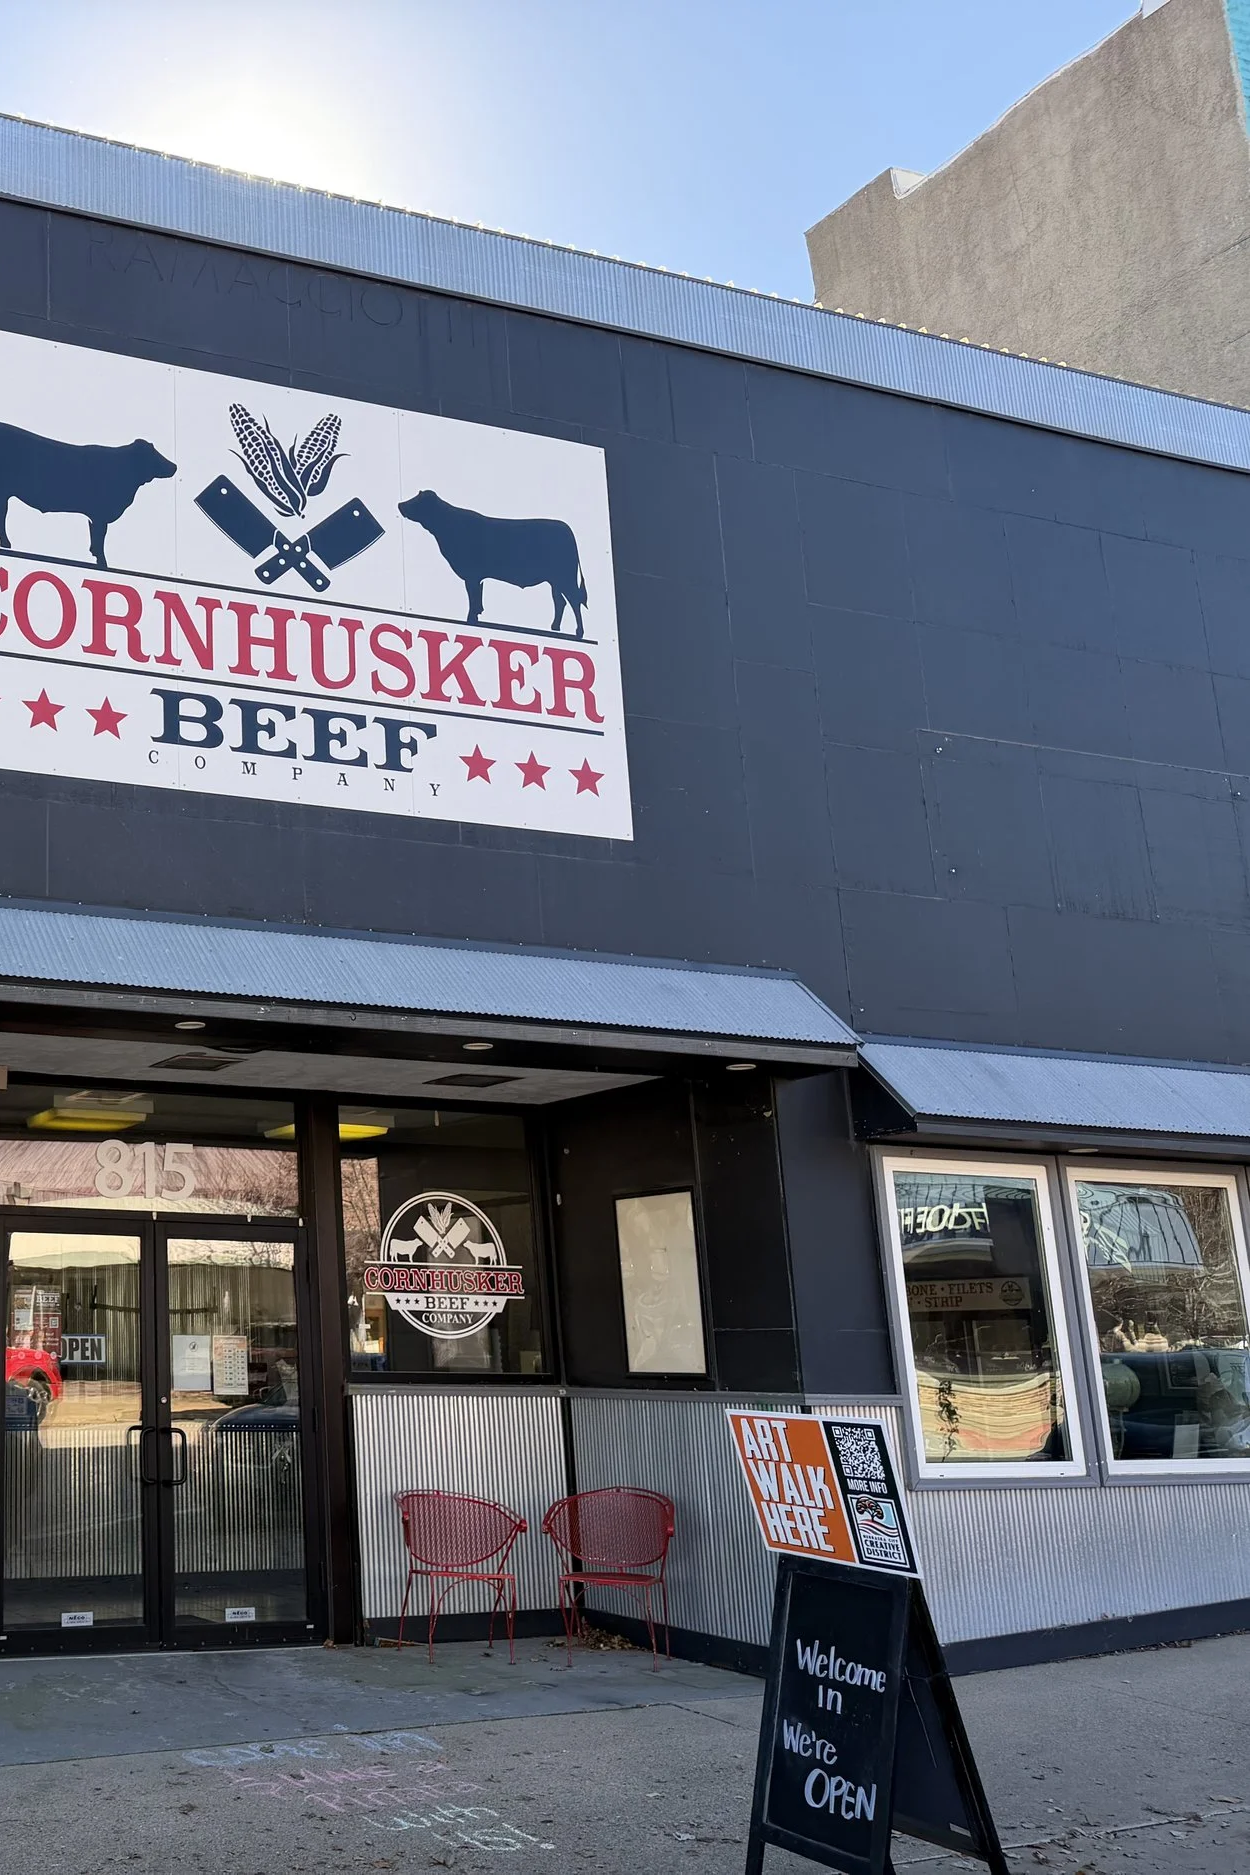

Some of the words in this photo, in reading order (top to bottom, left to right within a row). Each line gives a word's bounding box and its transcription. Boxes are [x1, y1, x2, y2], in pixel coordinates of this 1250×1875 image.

[150, 688, 437, 773] BEEF
[148, 750, 441, 797] COMPANY
[95, 1139, 196, 1200] 815
[364, 1267, 524, 1294] CORNHUSKER
[925, 1296, 962, 1308] STRIP
[948, 1282, 994, 1295] FILETS
[422, 1313, 473, 1324] COMPANY
[425, 1296, 470, 1310] BEEF
[740, 1418, 792, 1462] ART
[747, 1460, 835, 1510] WALK
[846, 1478, 869, 1492] MORE
[869, 1480, 888, 1494] INFO
[761, 1501, 835, 1552] HERE
[864, 1539, 900, 1551] CREATIVE
[866, 1548, 902, 1560] DISTRICT
[796, 1638, 886, 1693] Welcome
[782, 1719, 838, 1765] We're
[804, 1768, 877, 1821] OPEN
